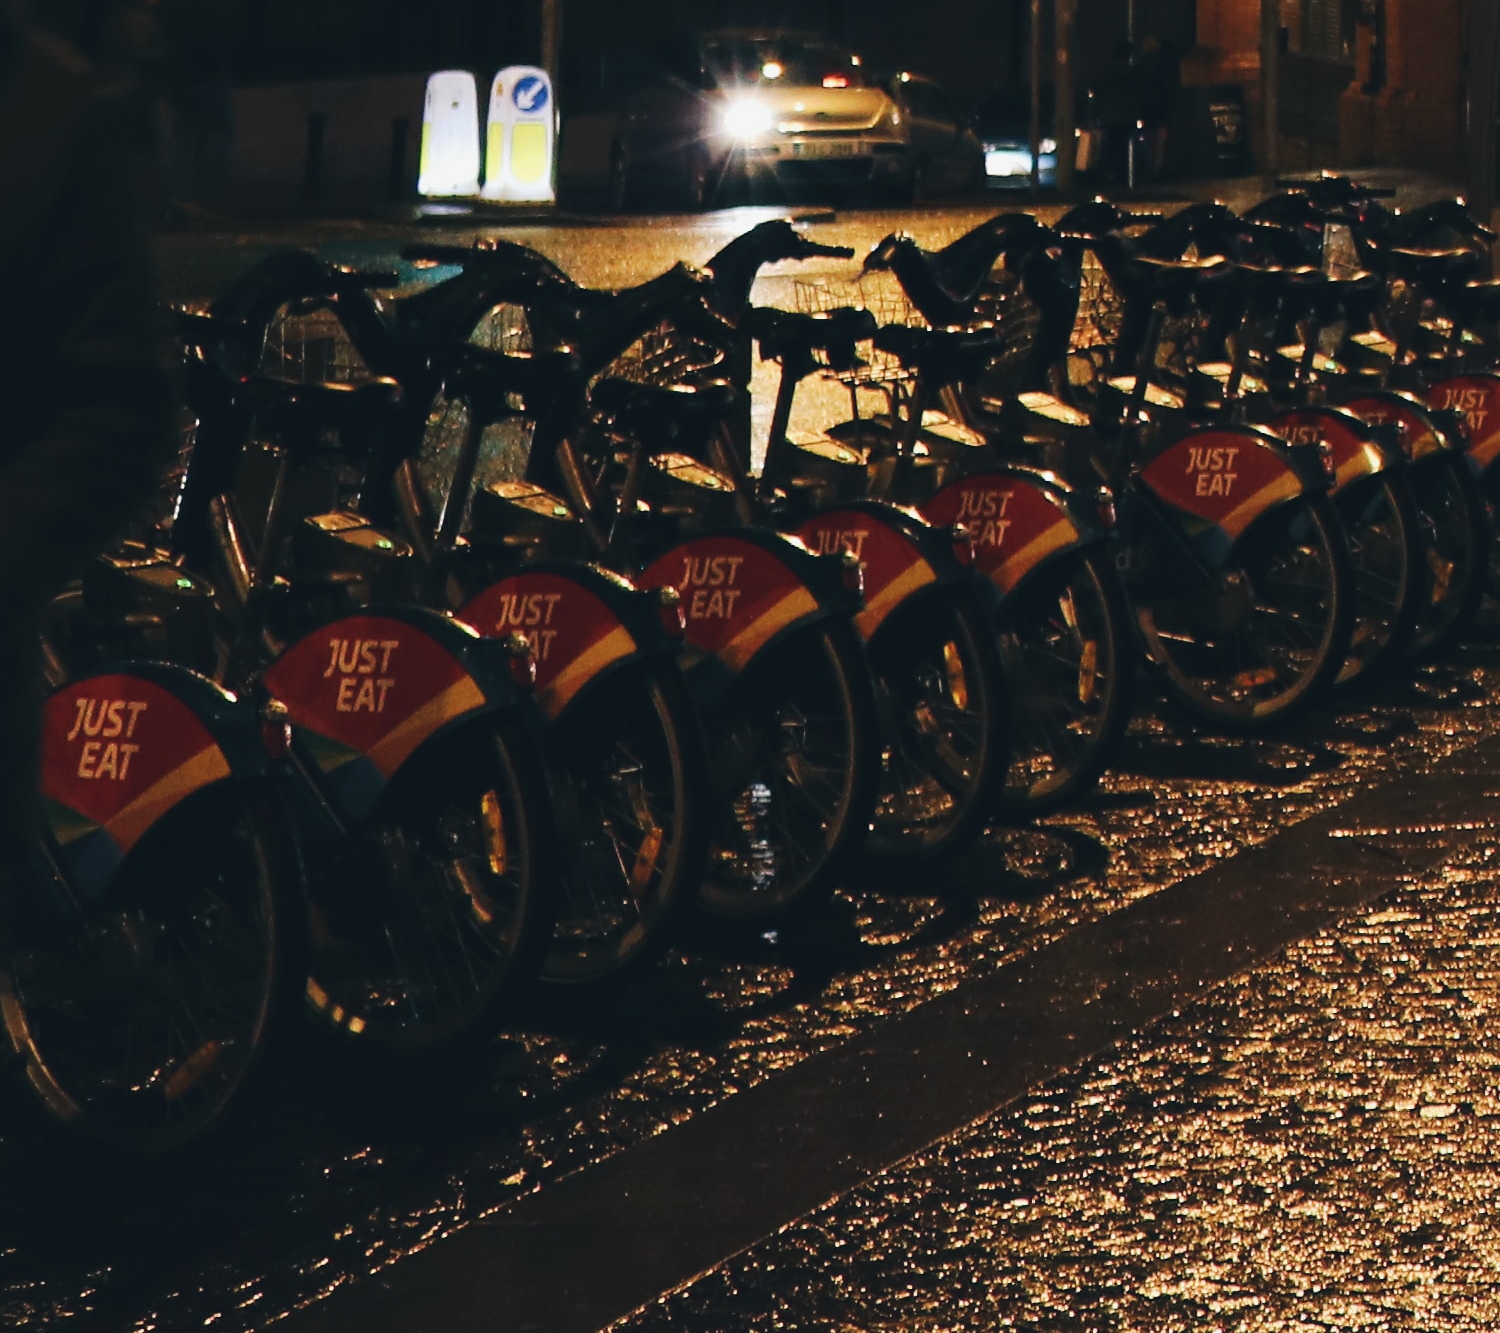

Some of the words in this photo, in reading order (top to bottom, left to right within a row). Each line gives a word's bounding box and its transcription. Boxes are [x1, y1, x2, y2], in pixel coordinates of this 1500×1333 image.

[1442, 389, 1489, 410] JUST
[1184, 446, 1240, 475] JUST
[1195, 473, 1238, 497] EAT
[956, 490, 1015, 521] JUST
[968, 518, 1012, 547] EAT
[679, 556, 744, 590] JUST
[495, 593, 562, 631] JUST
[689, 589, 742, 620] EAT
[323, 638, 400, 678] JUST
[511, 629, 558, 661] AT
[336, 677, 396, 714] EAT
[67, 697, 148, 741] JUST
[77, 741, 140, 781] EAT
